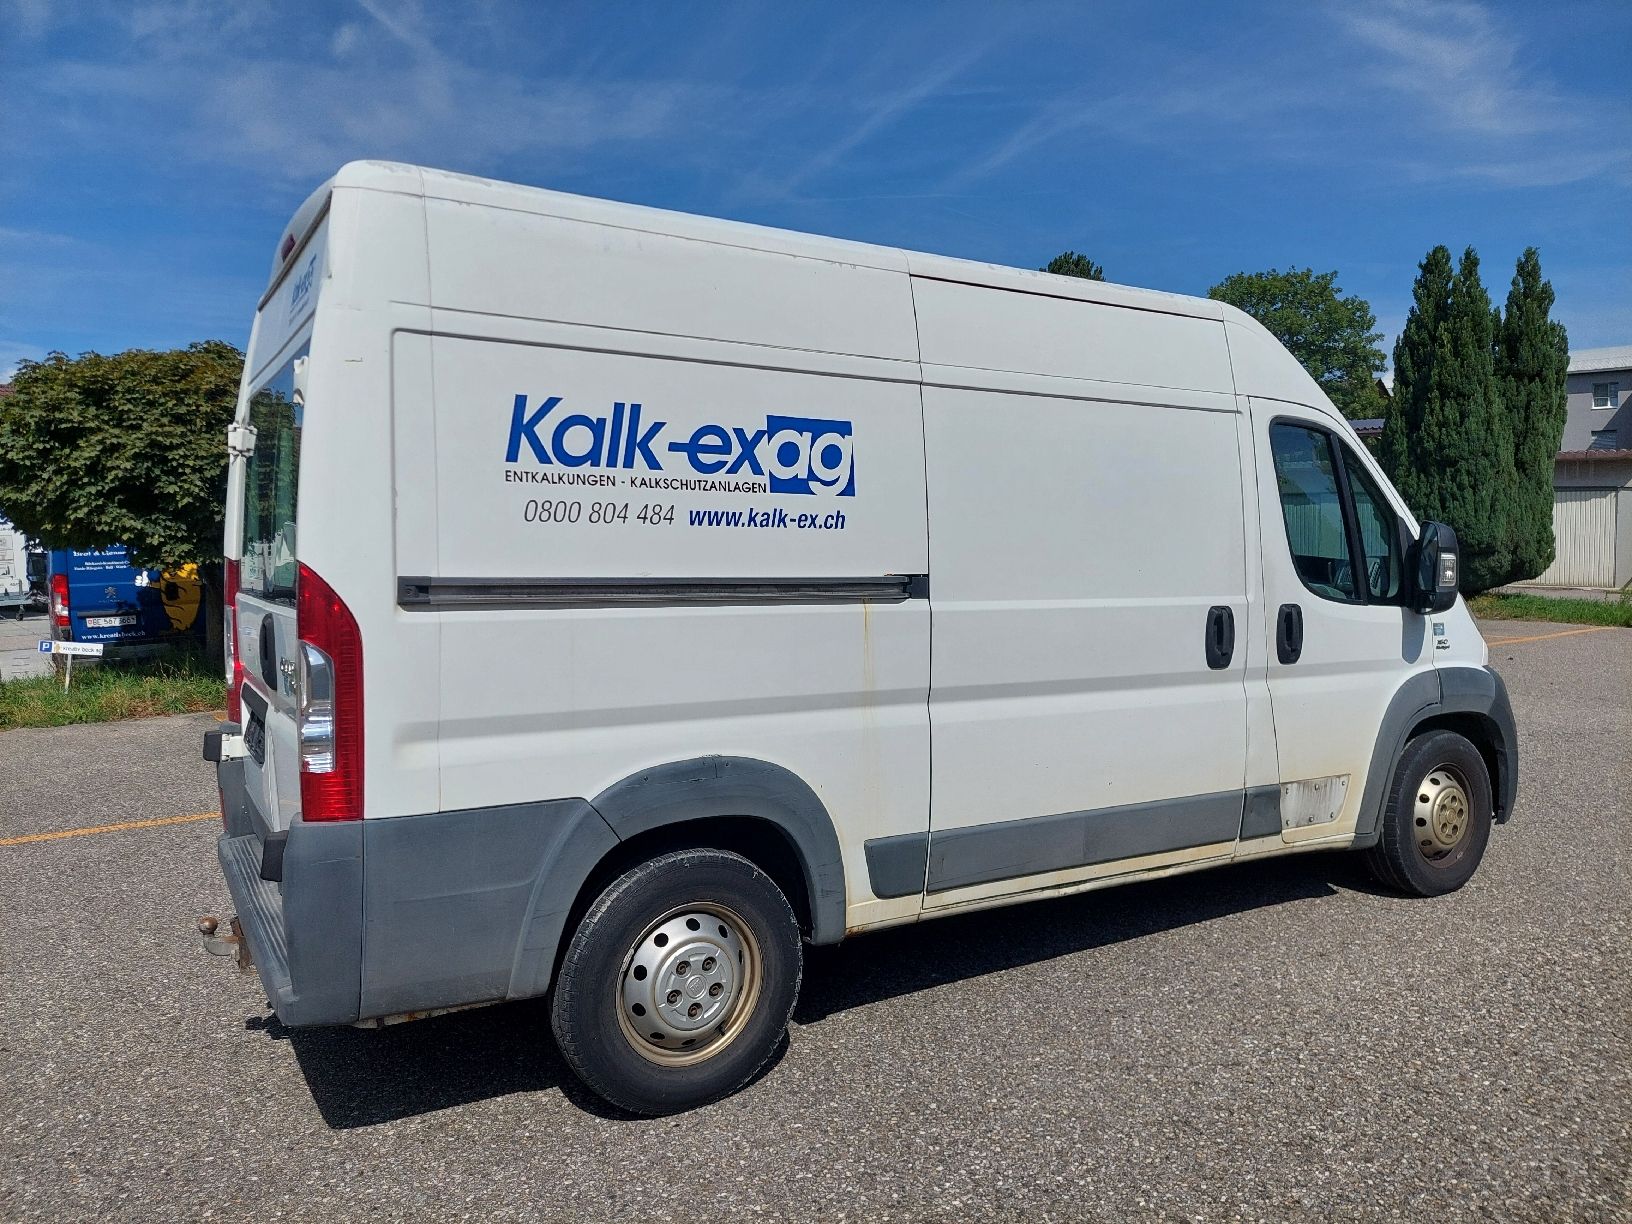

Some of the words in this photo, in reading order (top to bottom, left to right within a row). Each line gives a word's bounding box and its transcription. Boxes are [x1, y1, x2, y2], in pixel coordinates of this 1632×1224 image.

[504, 470, 616, 487] ENTKALKUNGEN
[630, 476, 767, 493] KALKSCHUTZANLAGEN
[523, 500, 581, 523] 0800
[588, 502, 629, 524] 804
[636, 504, 675, 525] 484
[688, 508, 846, 530] www.kalk-ex.ch
